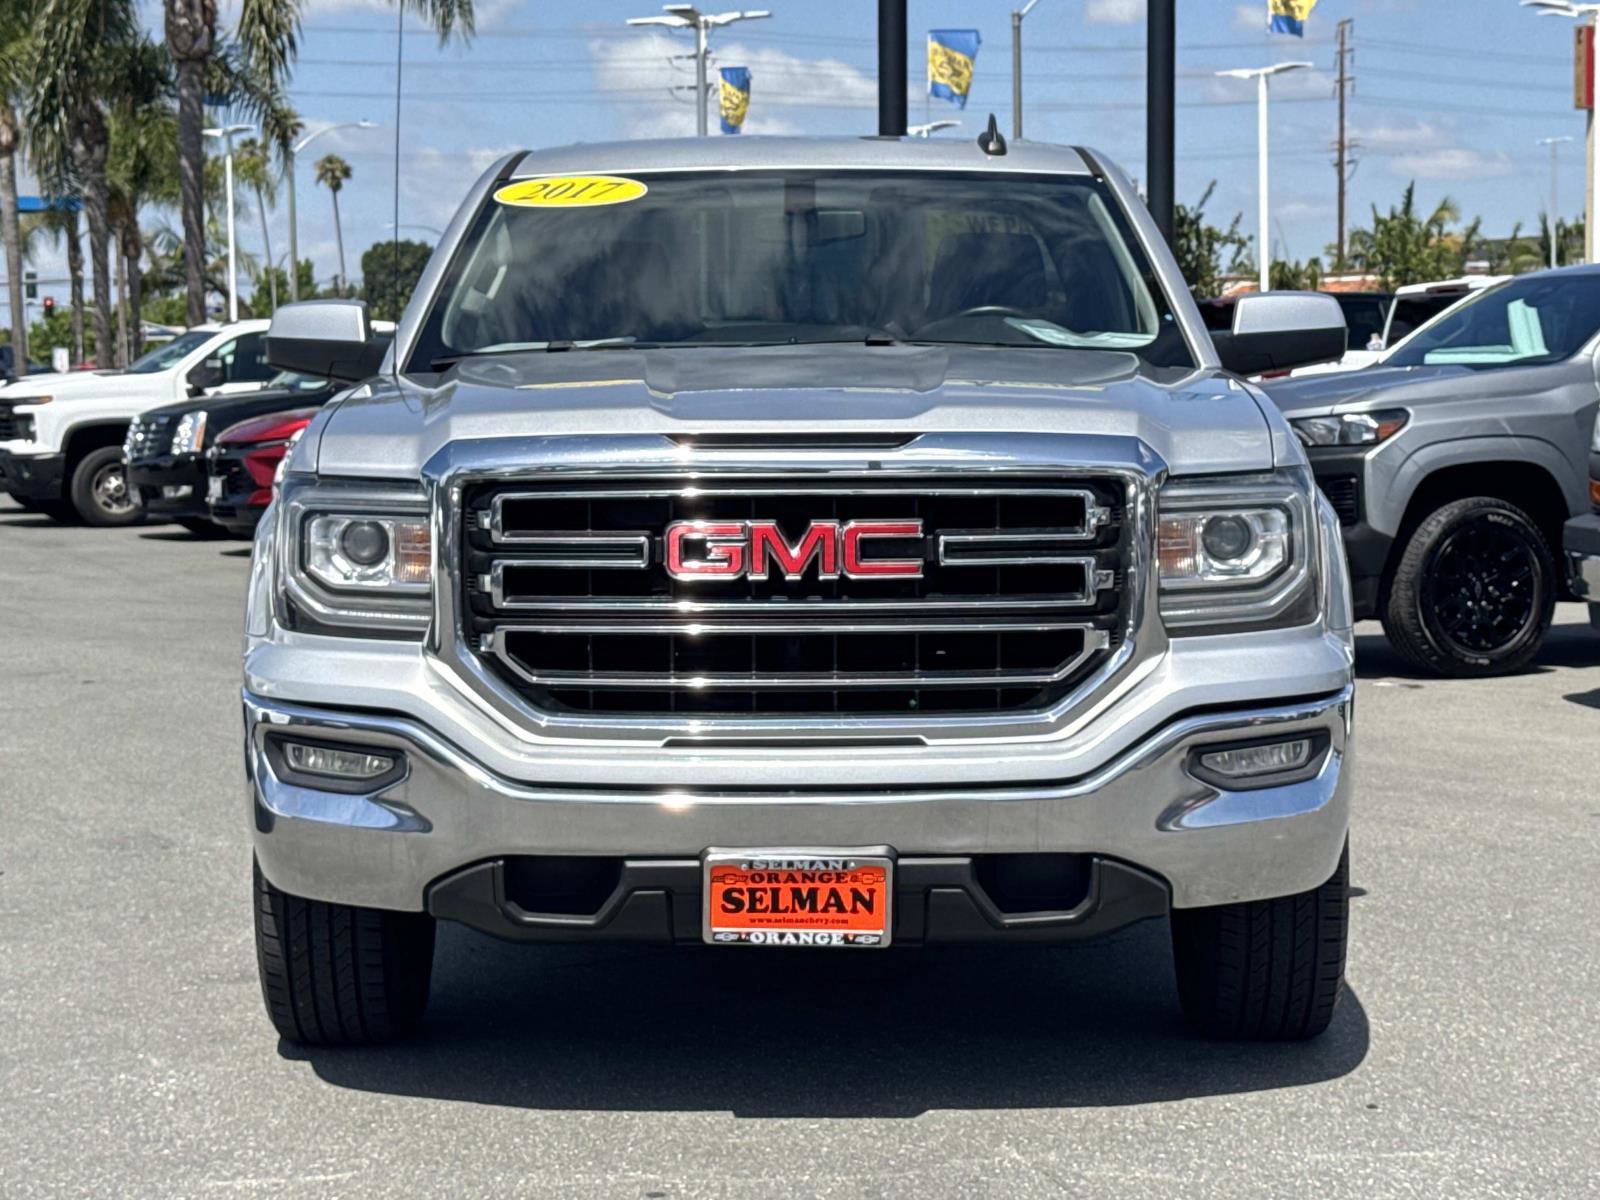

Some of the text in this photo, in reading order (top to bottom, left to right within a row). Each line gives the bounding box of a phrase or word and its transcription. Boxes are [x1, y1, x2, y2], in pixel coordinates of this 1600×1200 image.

[515, 181, 625, 200] 2017
[664, 519, 924, 580] GMC
[752, 860, 843, 870] SELMAN
[750, 872, 848, 884] ORANGE
[721, 887, 876, 914] SELMAN
[750, 931, 845, 945] ORANGE
